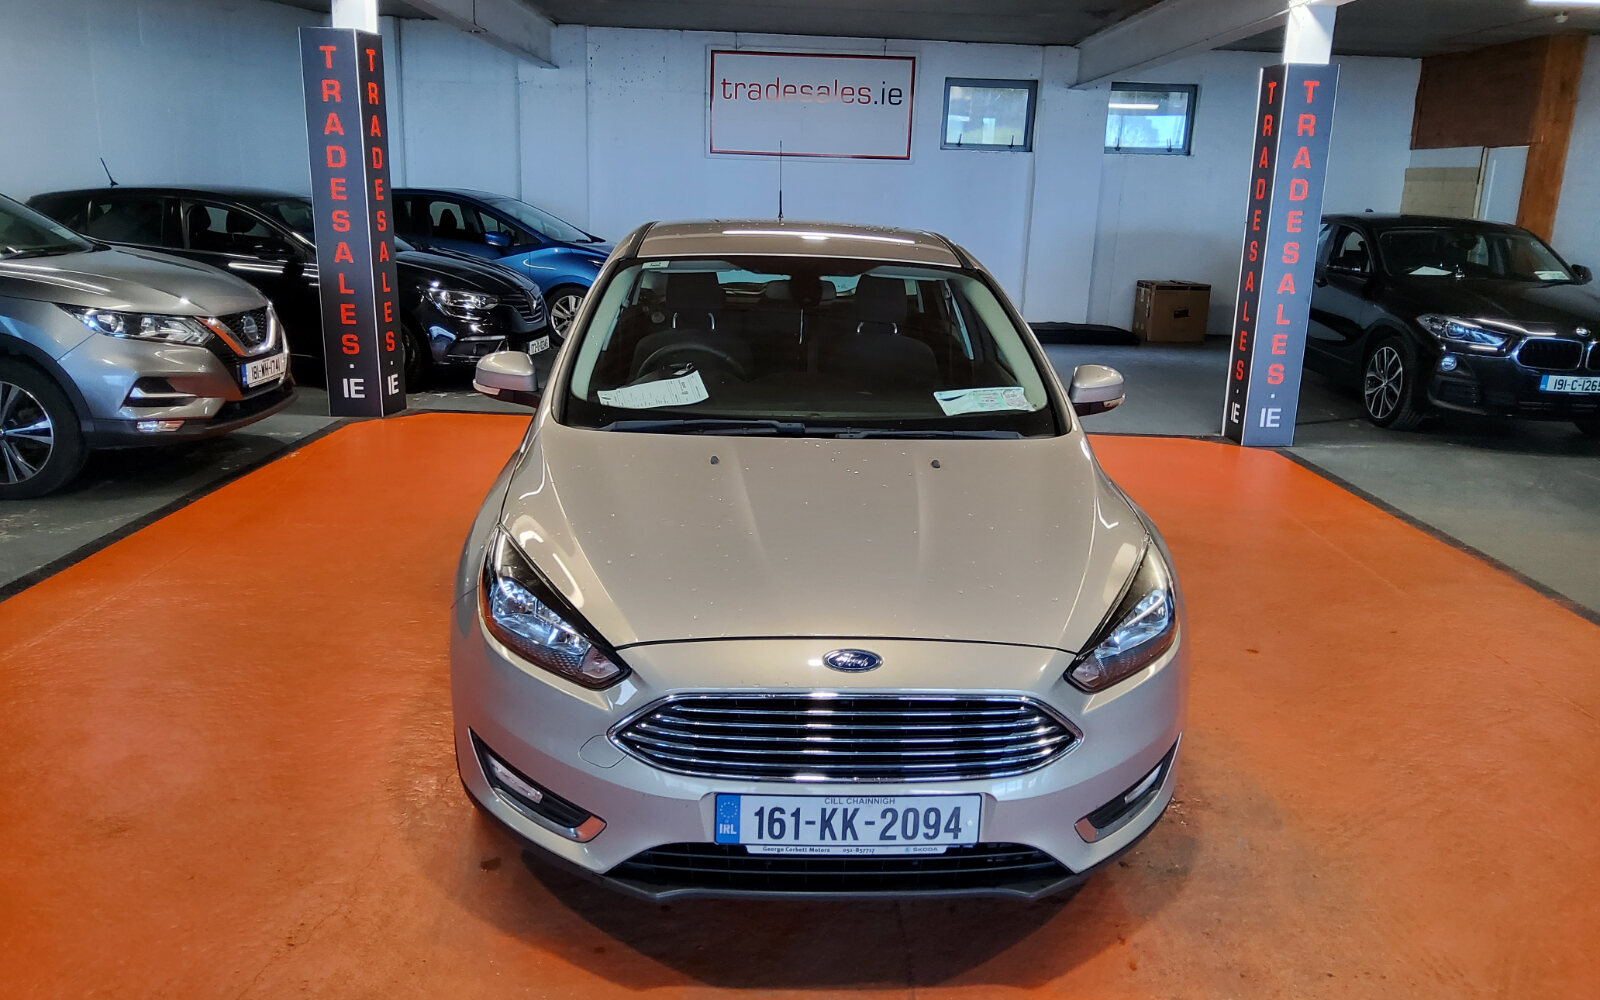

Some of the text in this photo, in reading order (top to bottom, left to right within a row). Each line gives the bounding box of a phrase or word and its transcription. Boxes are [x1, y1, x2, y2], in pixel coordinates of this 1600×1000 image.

[720, 76, 903, 106] tradesales.ie
[834, 653, 869, 667] Ford
[824, 797, 896, 805] CILL CHAINNIGH
[719, 823, 737, 835] IRL
[753, 806, 961, 840] 161-KK-2094
